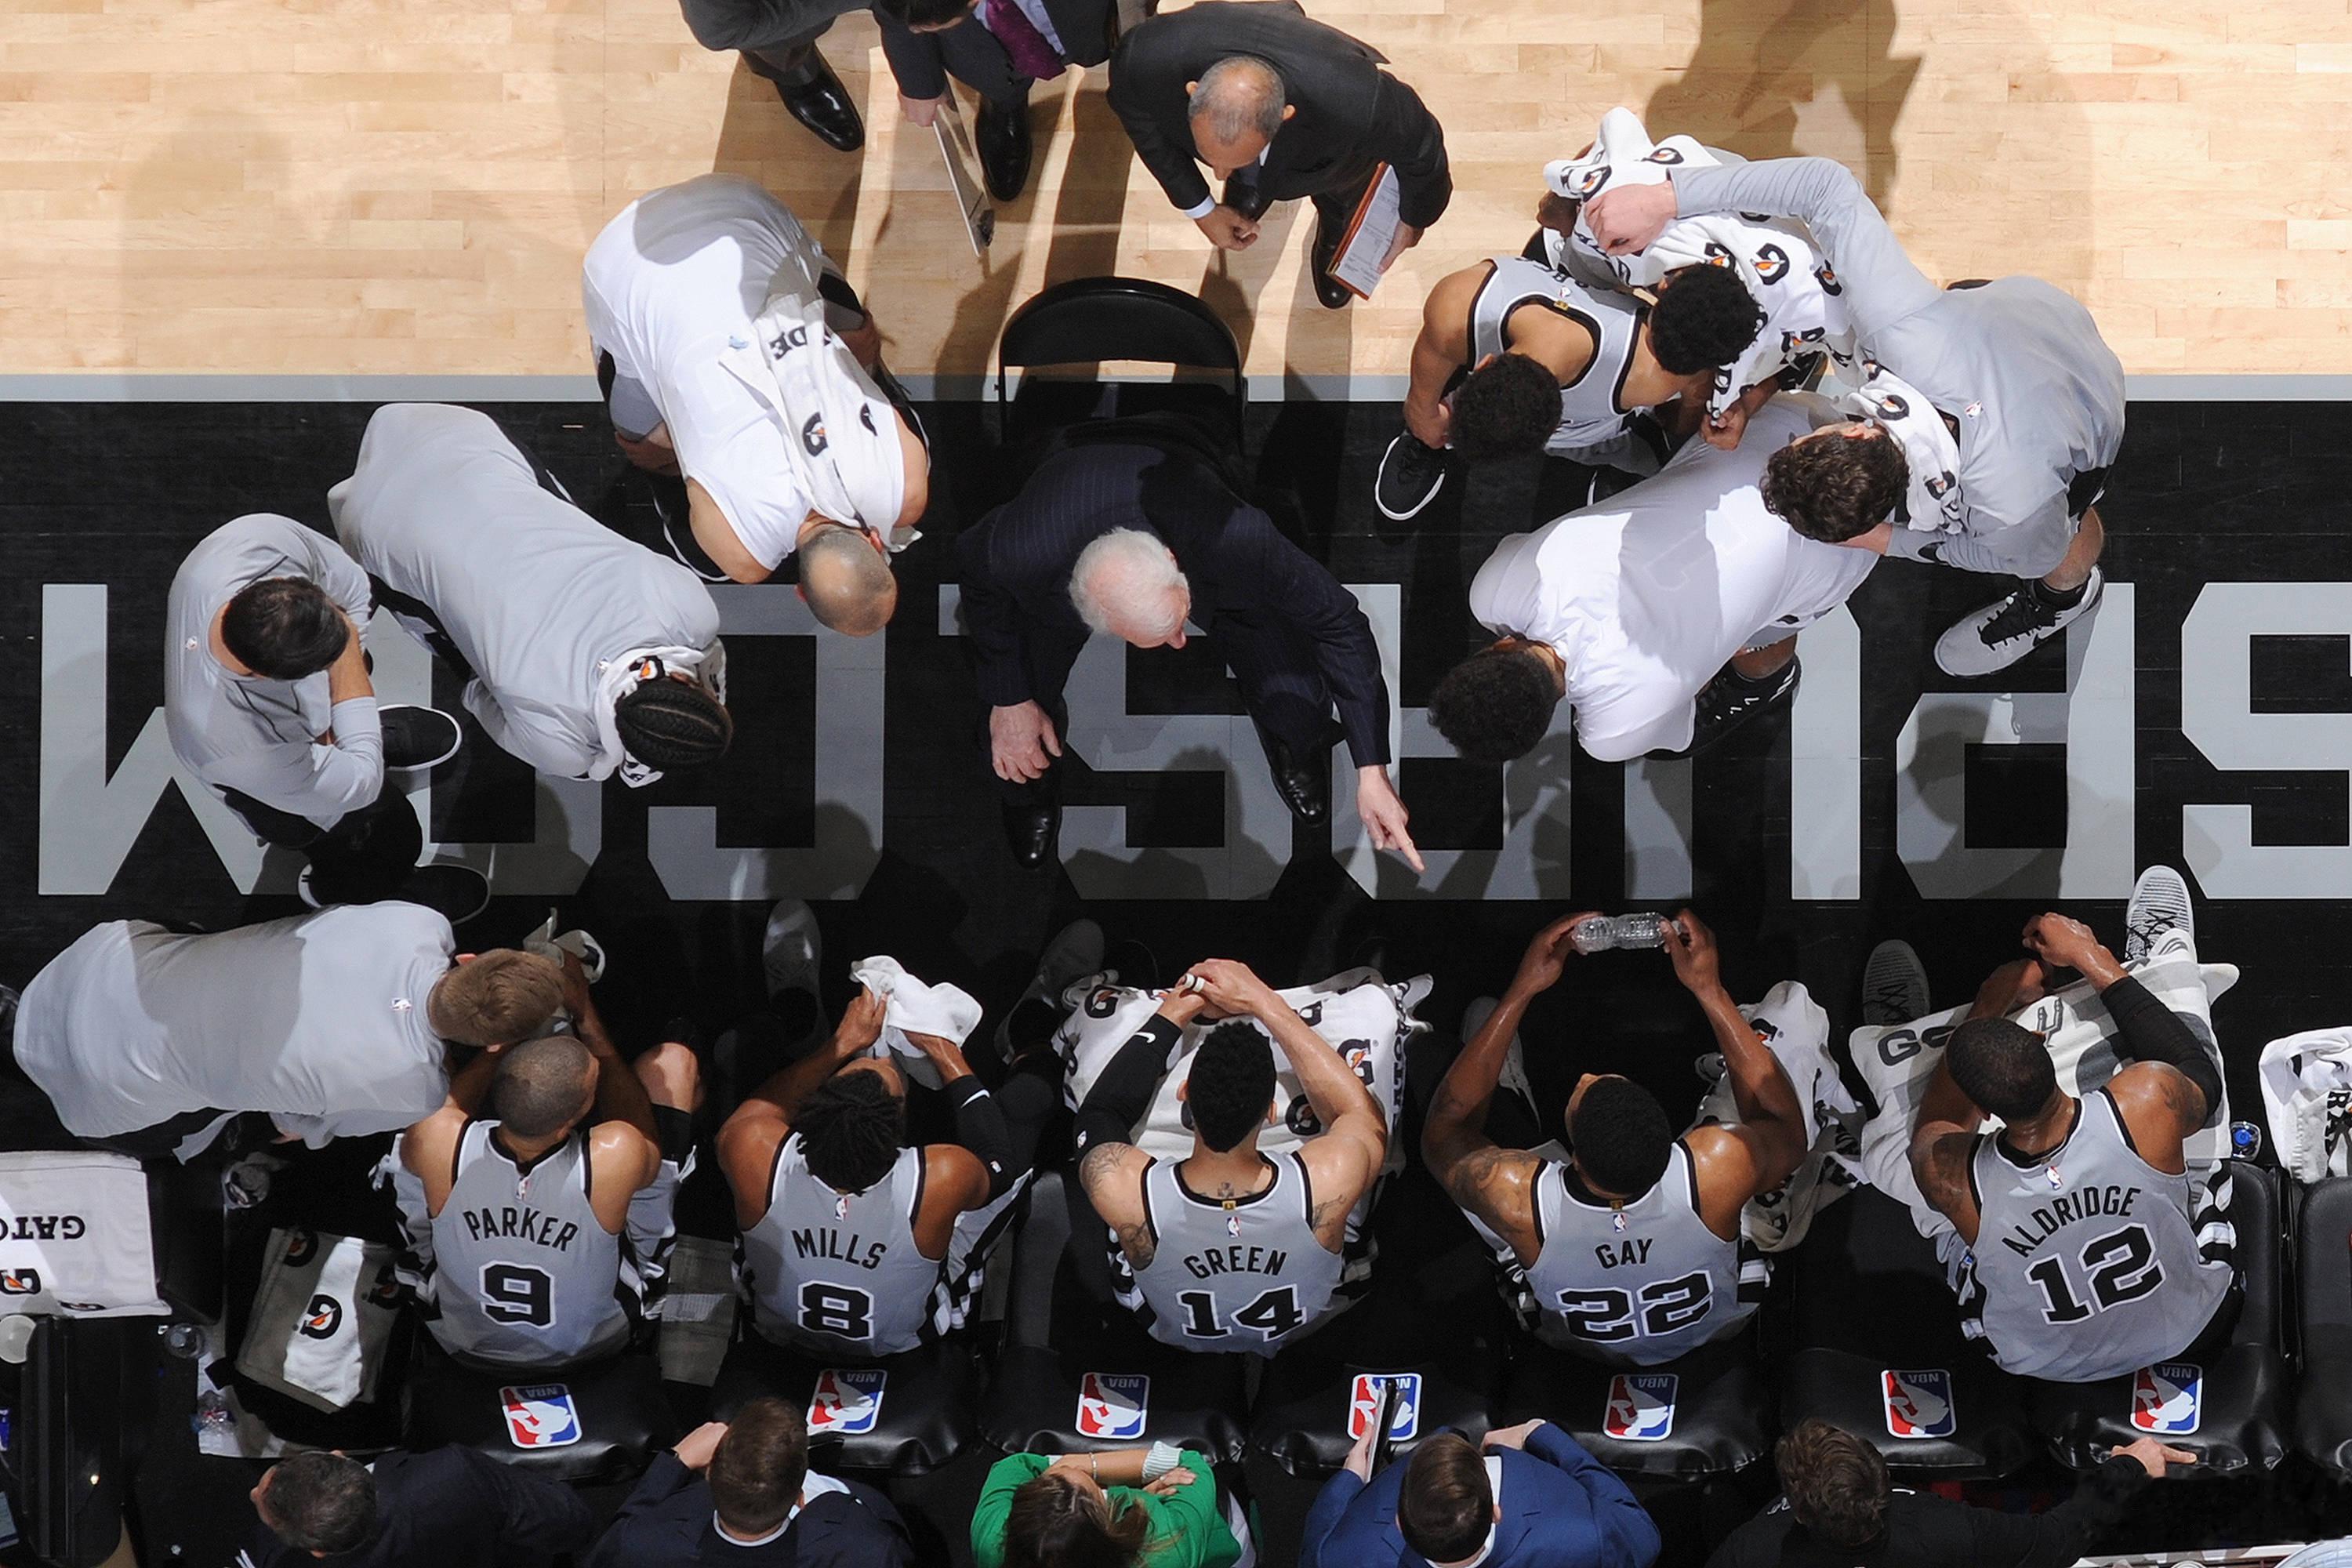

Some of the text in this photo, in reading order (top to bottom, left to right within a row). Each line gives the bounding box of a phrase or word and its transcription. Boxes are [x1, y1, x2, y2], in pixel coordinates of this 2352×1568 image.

[1750, 243, 1790, 285] G
[463, 1207, 579, 1252] PARKER
[2002, 1185, 2142, 1258] ALDRIDGE
[791, 1228, 887, 1270] MILLS
[1183, 1245, 1288, 1279] GREEN
[1595, 1238, 1653, 1269] GAY
[2024, 1221, 2167, 1325] 12
[479, 1260, 557, 1330] 9
[797, 1279, 874, 1341] 8
[1176, 1283, 1308, 1342] 14
[1556, 1270, 1714, 1344] 22
[299, 1294, 343, 1340] G
[526, 1387, 557, 1397] NBA
[846, 1373, 877, 1382] NBA
[1108, 1377, 1139, 1388] NBA
[1637, 1377, 1668, 1388] NBA
[1908, 1374, 1939, 1383] NBA
[2161, 1367, 2192, 1378] NBA
